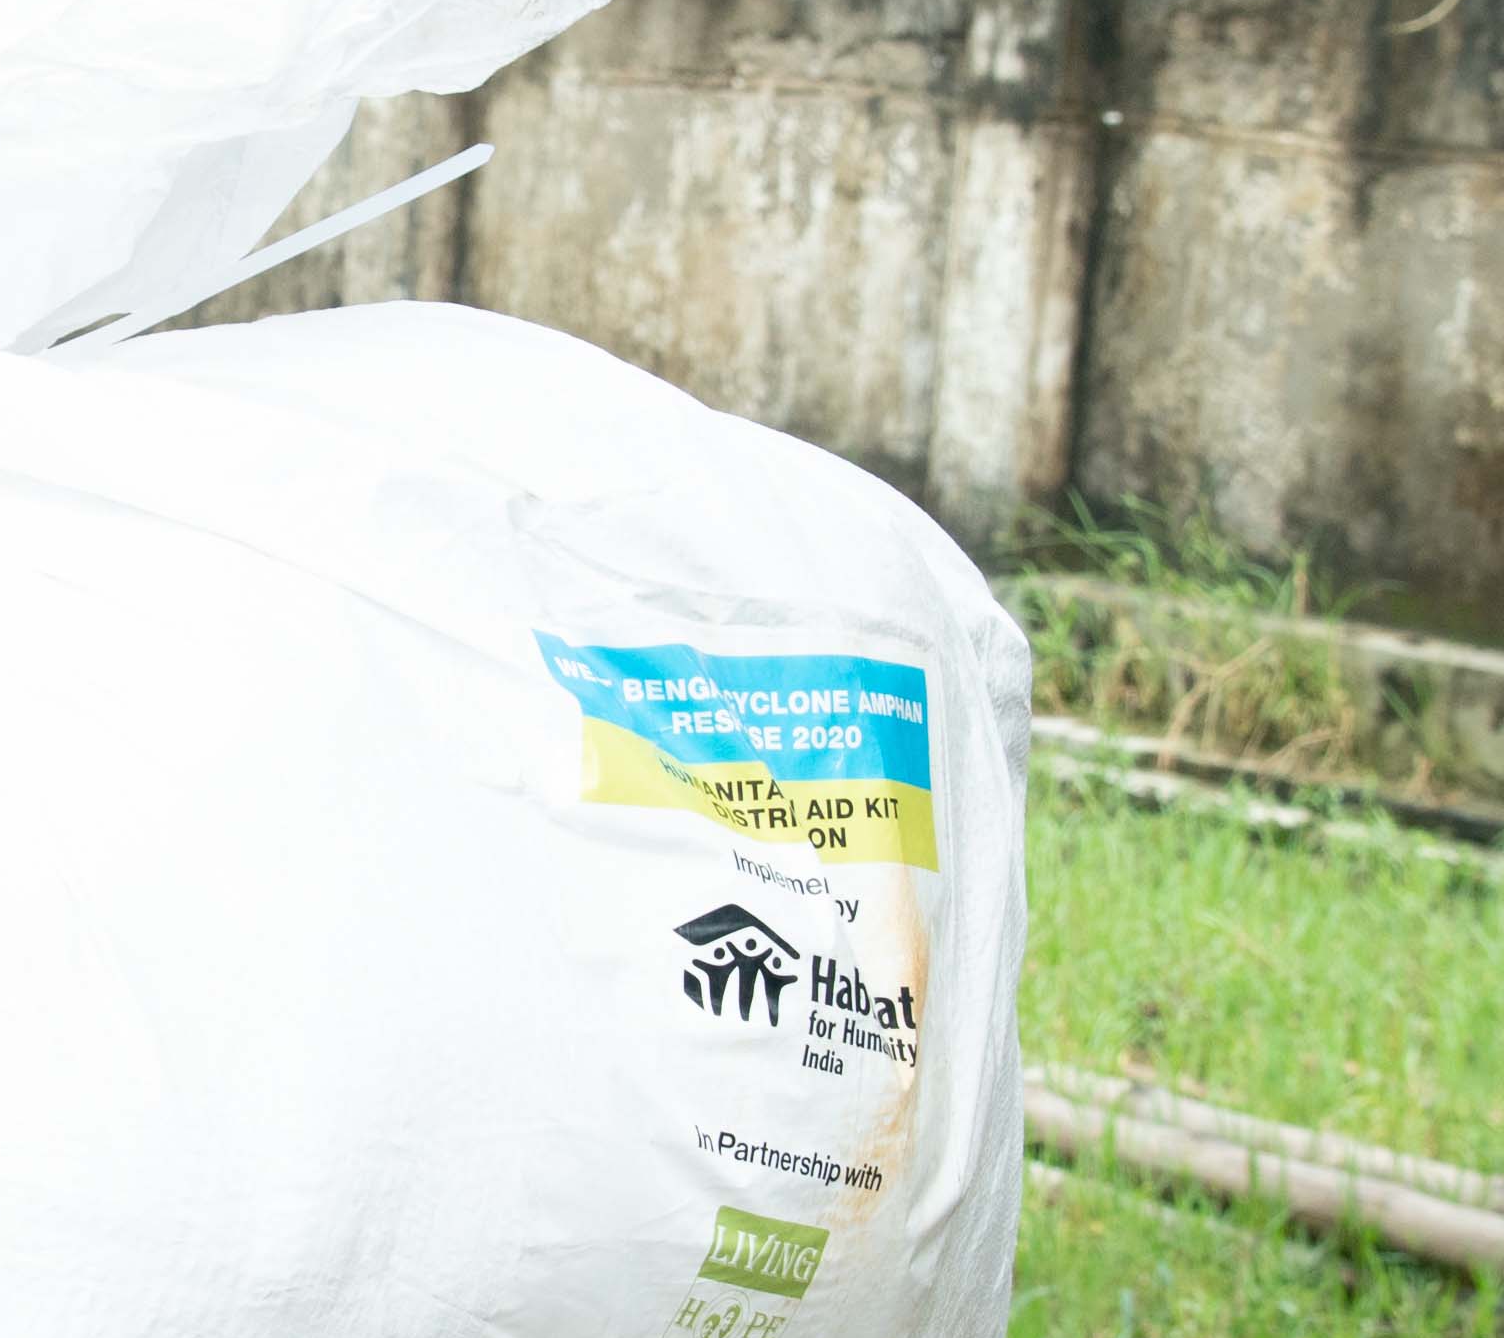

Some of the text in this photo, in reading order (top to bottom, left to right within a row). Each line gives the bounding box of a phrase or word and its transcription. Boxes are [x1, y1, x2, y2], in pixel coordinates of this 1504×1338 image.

[857, 691, 923, 724] AMPHAN
[792, 725, 863, 750] 2020
[806, 798, 855, 821] AID
[866, 797, 899, 820] KIT
[811, 955, 917, 1030] Habat
[808, 1010, 837, 1040] for
[802, 1044, 844, 1075] India
[695, 1125, 883, 1192] In Partnership with
[708, 1224, 820, 1283] LIVING
